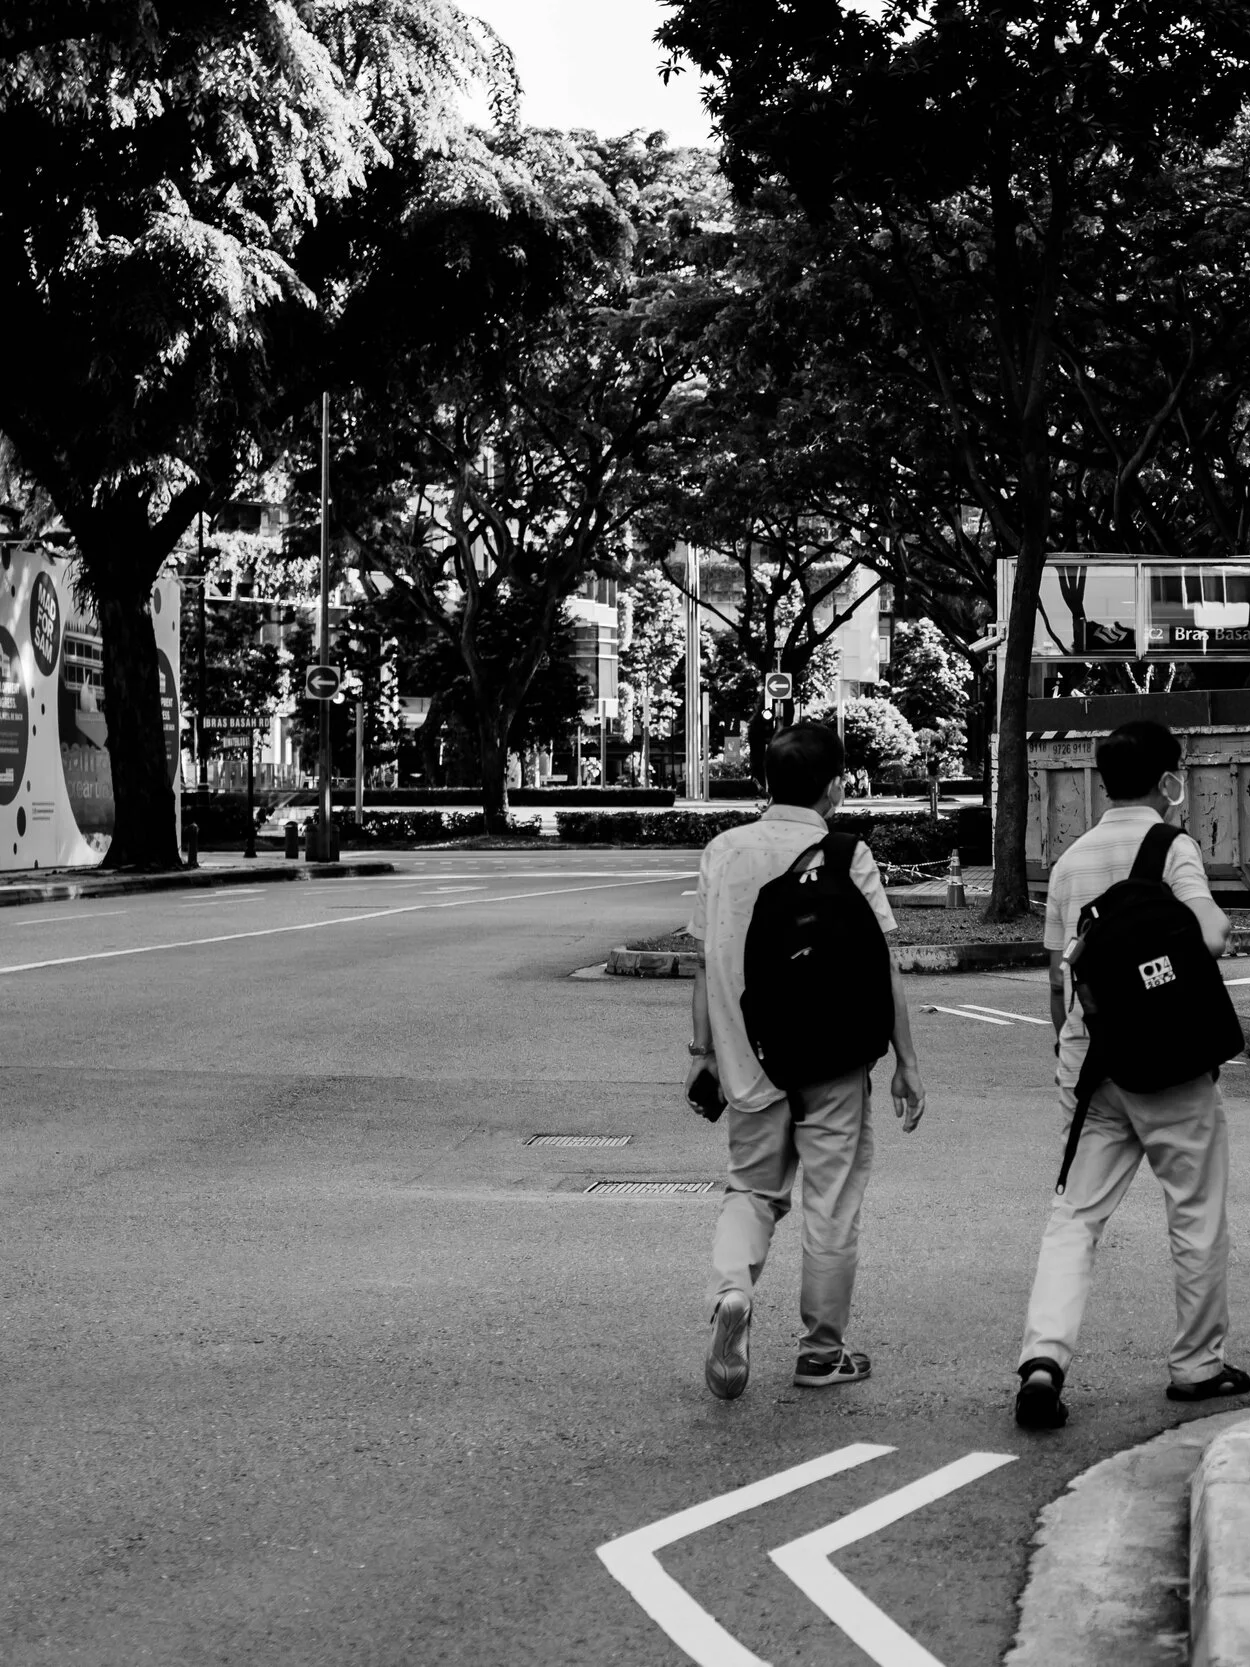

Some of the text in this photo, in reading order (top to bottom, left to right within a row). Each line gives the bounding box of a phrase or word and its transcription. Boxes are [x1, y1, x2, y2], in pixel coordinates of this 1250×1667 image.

[38, 582, 56, 621] MAD
[37, 605, 54, 641] FOR
[1175, 626, 1210, 641] Bras
[34, 625, 53, 664] SAM
[206, 717, 270, 728] BRAS BASAH RD
[1052, 743, 1071, 755] 9726
[1073, 742, 1092, 754] 9118
